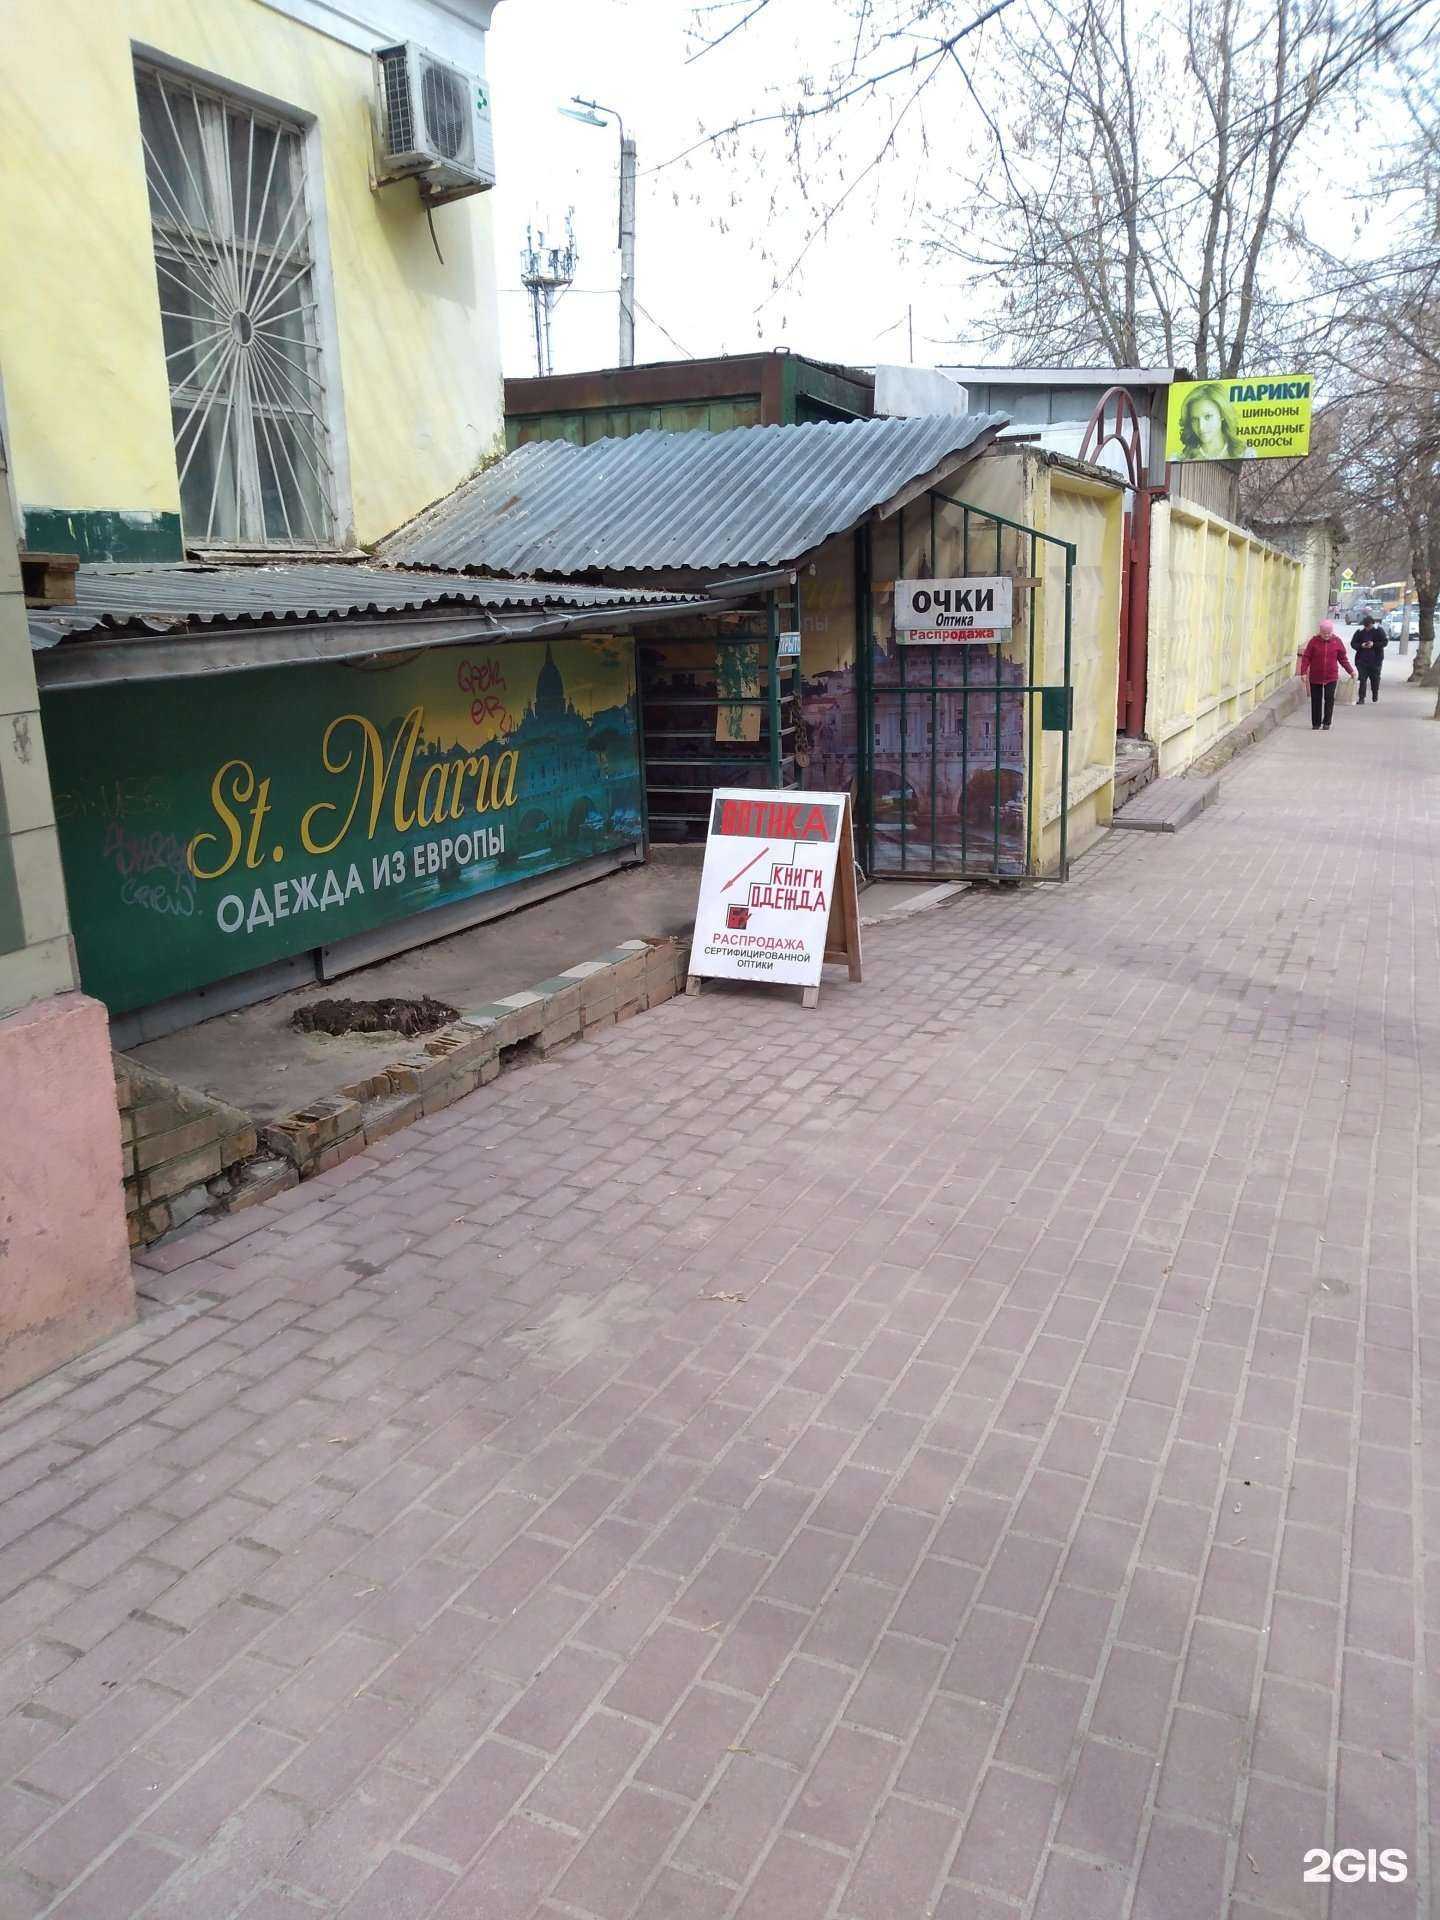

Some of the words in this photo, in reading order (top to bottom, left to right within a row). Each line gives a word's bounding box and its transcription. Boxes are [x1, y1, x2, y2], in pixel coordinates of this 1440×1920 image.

[1229, 382, 1310, 402] ПАРИКИ
[1242, 407, 1300, 419] ШИНЬОНЫ
[1236, 424, 1305, 436] НАКЛАДНЫЕ
[1246, 437, 1293, 448] ВОЛОСЫ
[912, 588, 994, 614] ОЧКИ
[936, 612, 975, 627] Оптика
[909, 629, 995, 642] Распродажа
[186, 759, 284, 880] St.
[301, 705, 520, 855] Maria
[720, 799, 831, 841] ОПТИКА
[217, 862, 365, 934] ОДЕЖДА
[373, 856, 407, 891] ИЗ
[414, 824, 505, 879] ЕВРОПЫ
[773, 866, 823, 889] КНИГИ
[751, 885, 826, 912] ОДЕЖДА
[712, 933, 805, 951] РАСПРОДАЖА
[704, 946, 811, 963] СЕРТИФИЦИРОВАННОЙ
[737, 959, 774, 970] ОПТИКИ
